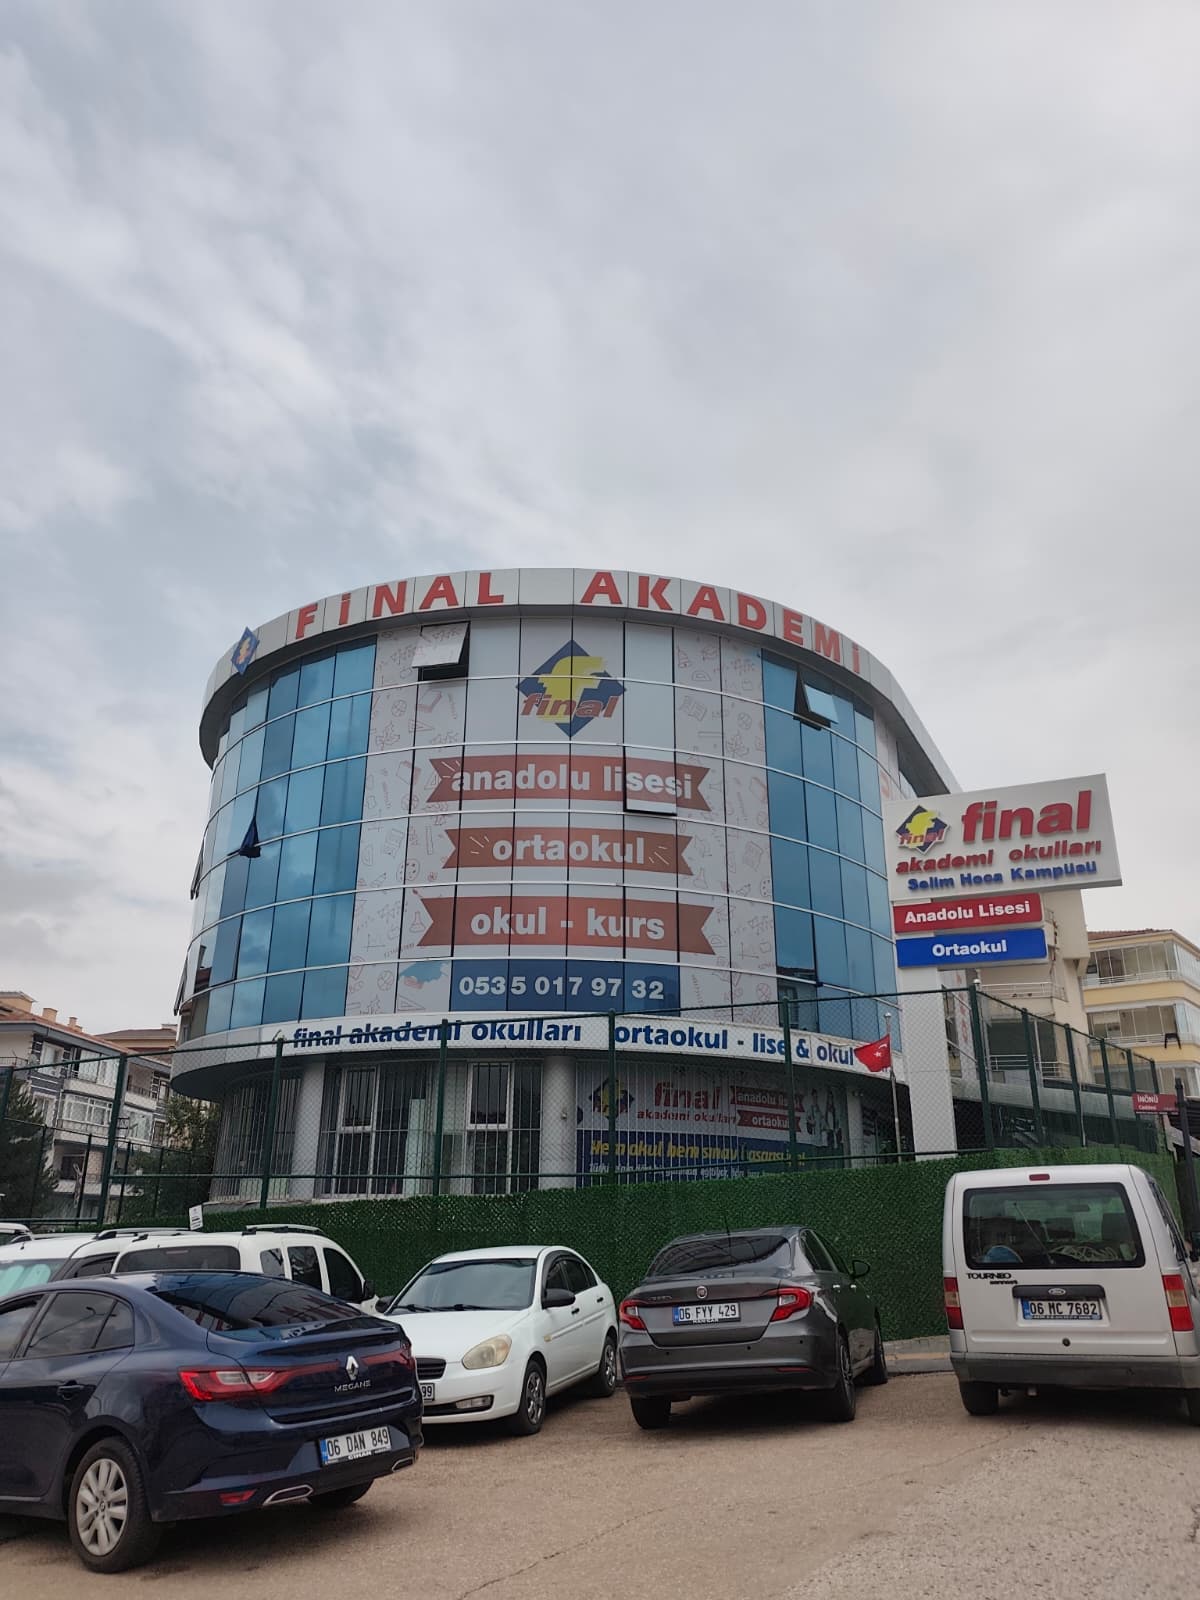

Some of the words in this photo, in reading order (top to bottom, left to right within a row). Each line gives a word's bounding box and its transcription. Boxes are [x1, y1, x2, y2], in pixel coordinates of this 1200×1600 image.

[521, 693, 619, 718] final
[451, 764, 590, 792] anadolu
[603, 766, 692, 799] lisesi
[961, 790, 1092, 844] final
[492, 835, 645, 864] ortaokul
[896, 849, 994, 874] akademi
[1008, 840, 1102, 861] okulları
[908, 876, 954, 891] Selim
[1011, 861, 1097, 881] Kampüsü
[471, 907, 547, 935] okul
[587, 908, 665, 940] kurs
[905, 905, 973, 924] Anadolu
[979, 901, 1030, 917] Lisesi
[932, 940, 1007, 957] Ortaokul
[458, 976, 526, 996] 0535
[534, 976, 583, 996] 017
[591, 977, 622, 996] 97
[631, 980, 664, 1000] 32
[293, 1025, 342, 1048] final
[471, 1018, 581, 1042] okulları
[614, 1025, 728, 1049] ortaokul
[795, 1039, 810, 1059] &
[816, 1042, 854, 1066] okul
[654, 1082, 720, 1109] final
[679, 1308, 691, 1320] 06
[696, 1306, 713, 1318] FYY
[718, 1305, 737, 1317] 429
[1030, 1302, 1045, 1315] 06
[1067, 1302, 1098, 1315] 7682
[334, 1380, 371, 1392] MEGANE
[327, 1439, 341, 1457] 06
[346, 1434, 366, 1453] DAN
[371, 1428, 389, 1449] 849
